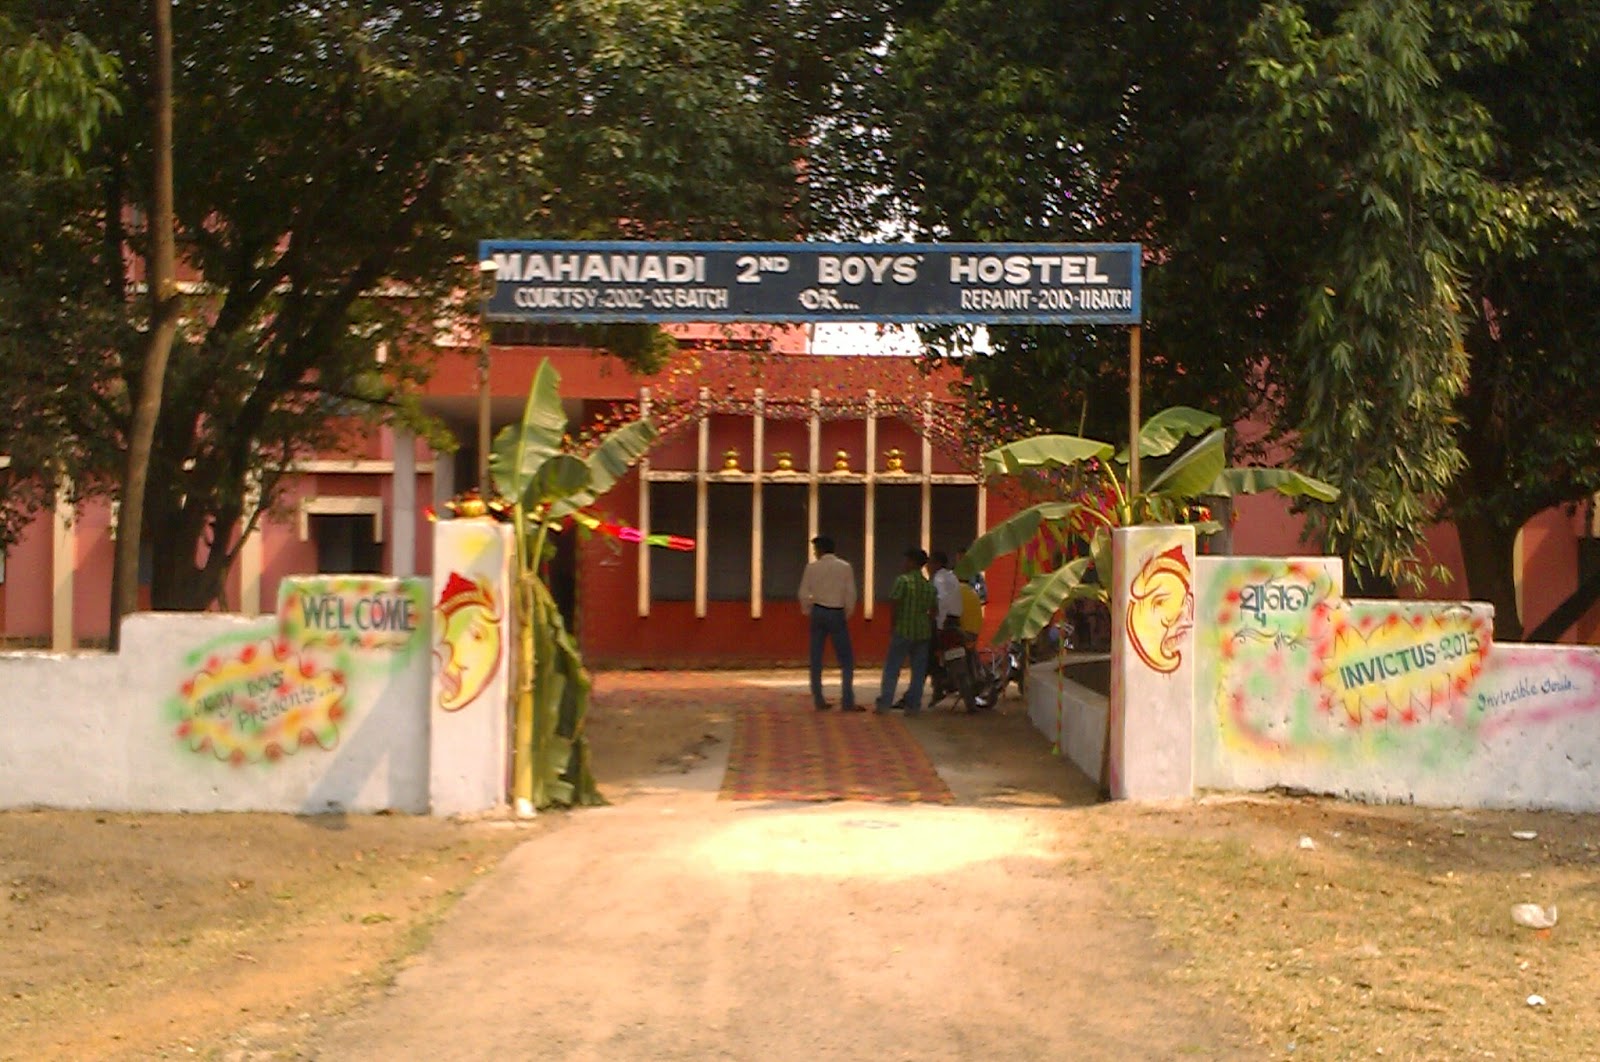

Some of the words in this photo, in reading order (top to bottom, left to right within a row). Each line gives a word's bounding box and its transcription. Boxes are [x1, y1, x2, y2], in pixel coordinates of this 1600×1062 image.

[492, 253, 706, 283] MAHANADI
[735, 255, 790, 284] 2ND
[949, 255, 1109, 284] HOSTEL
